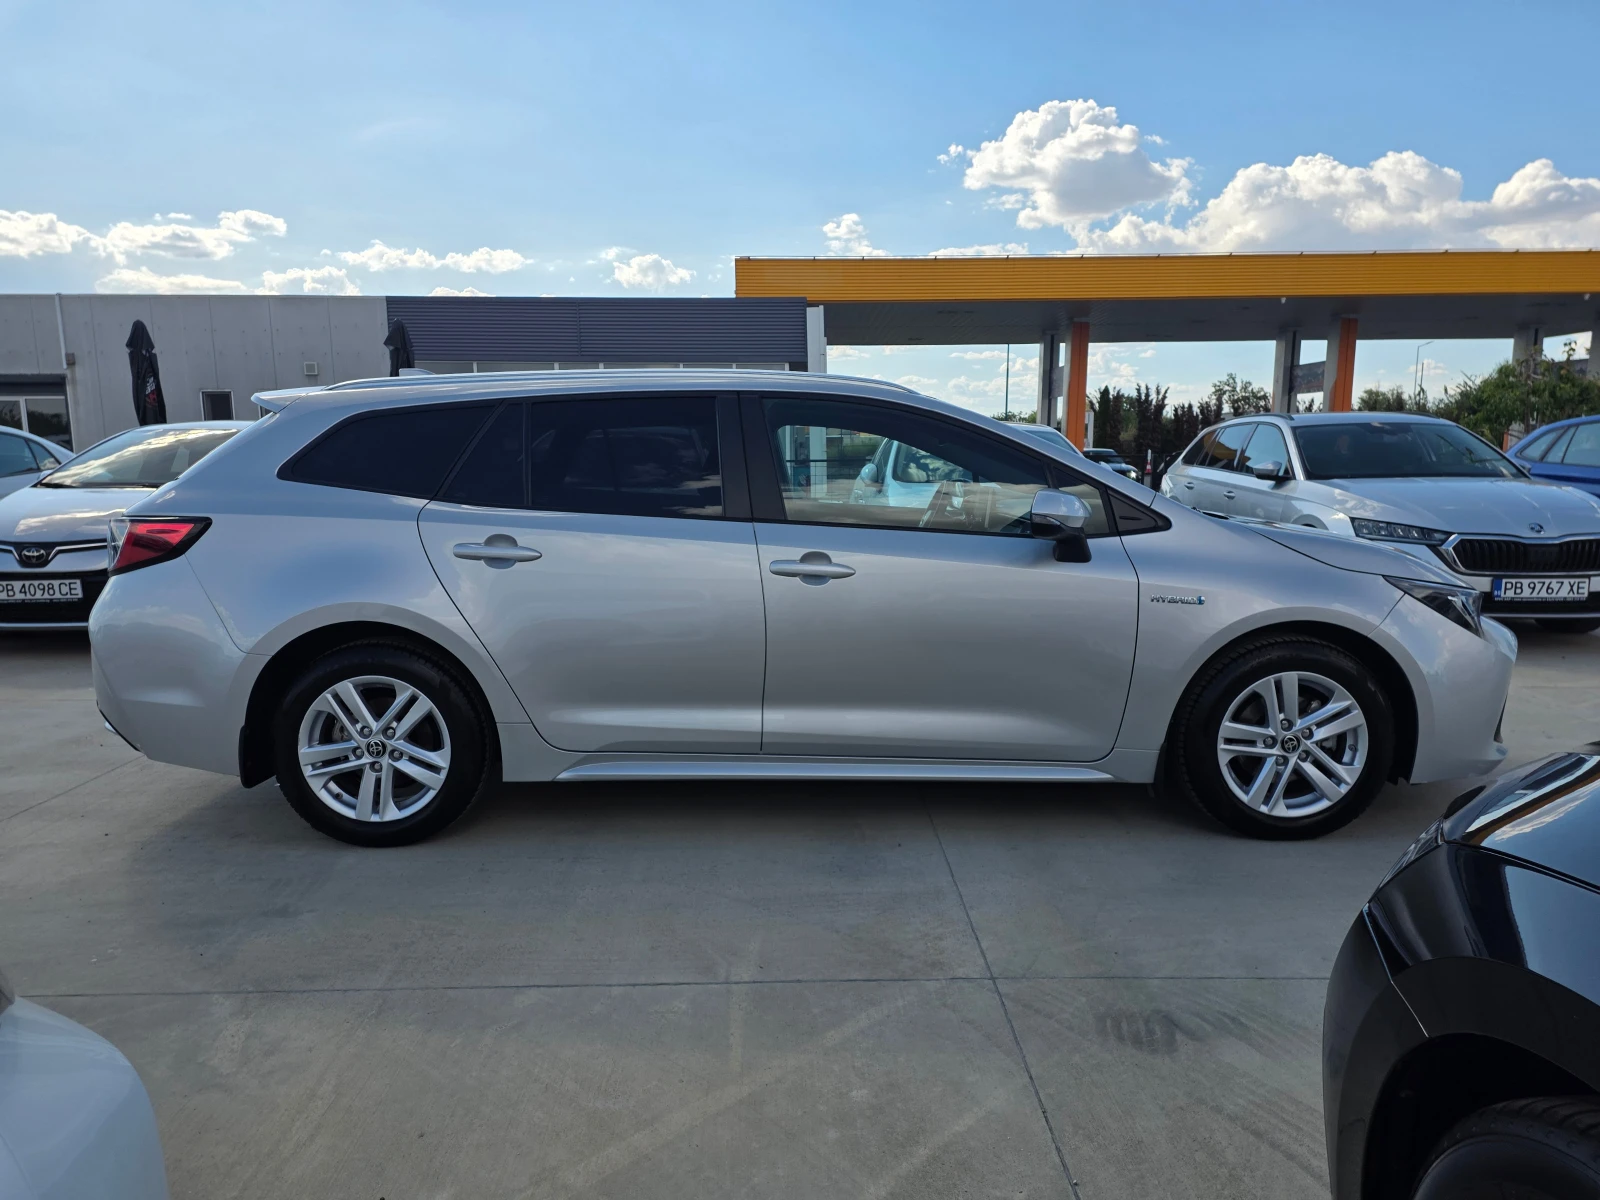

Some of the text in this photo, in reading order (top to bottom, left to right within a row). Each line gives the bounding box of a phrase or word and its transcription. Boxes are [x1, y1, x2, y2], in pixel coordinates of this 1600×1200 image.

[19, 582, 56, 597] 4098
[58, 581, 79, 596] CE
[1503, 581, 1587, 596] PB 9767 XE
[1150, 594, 1198, 605] HYBRID
